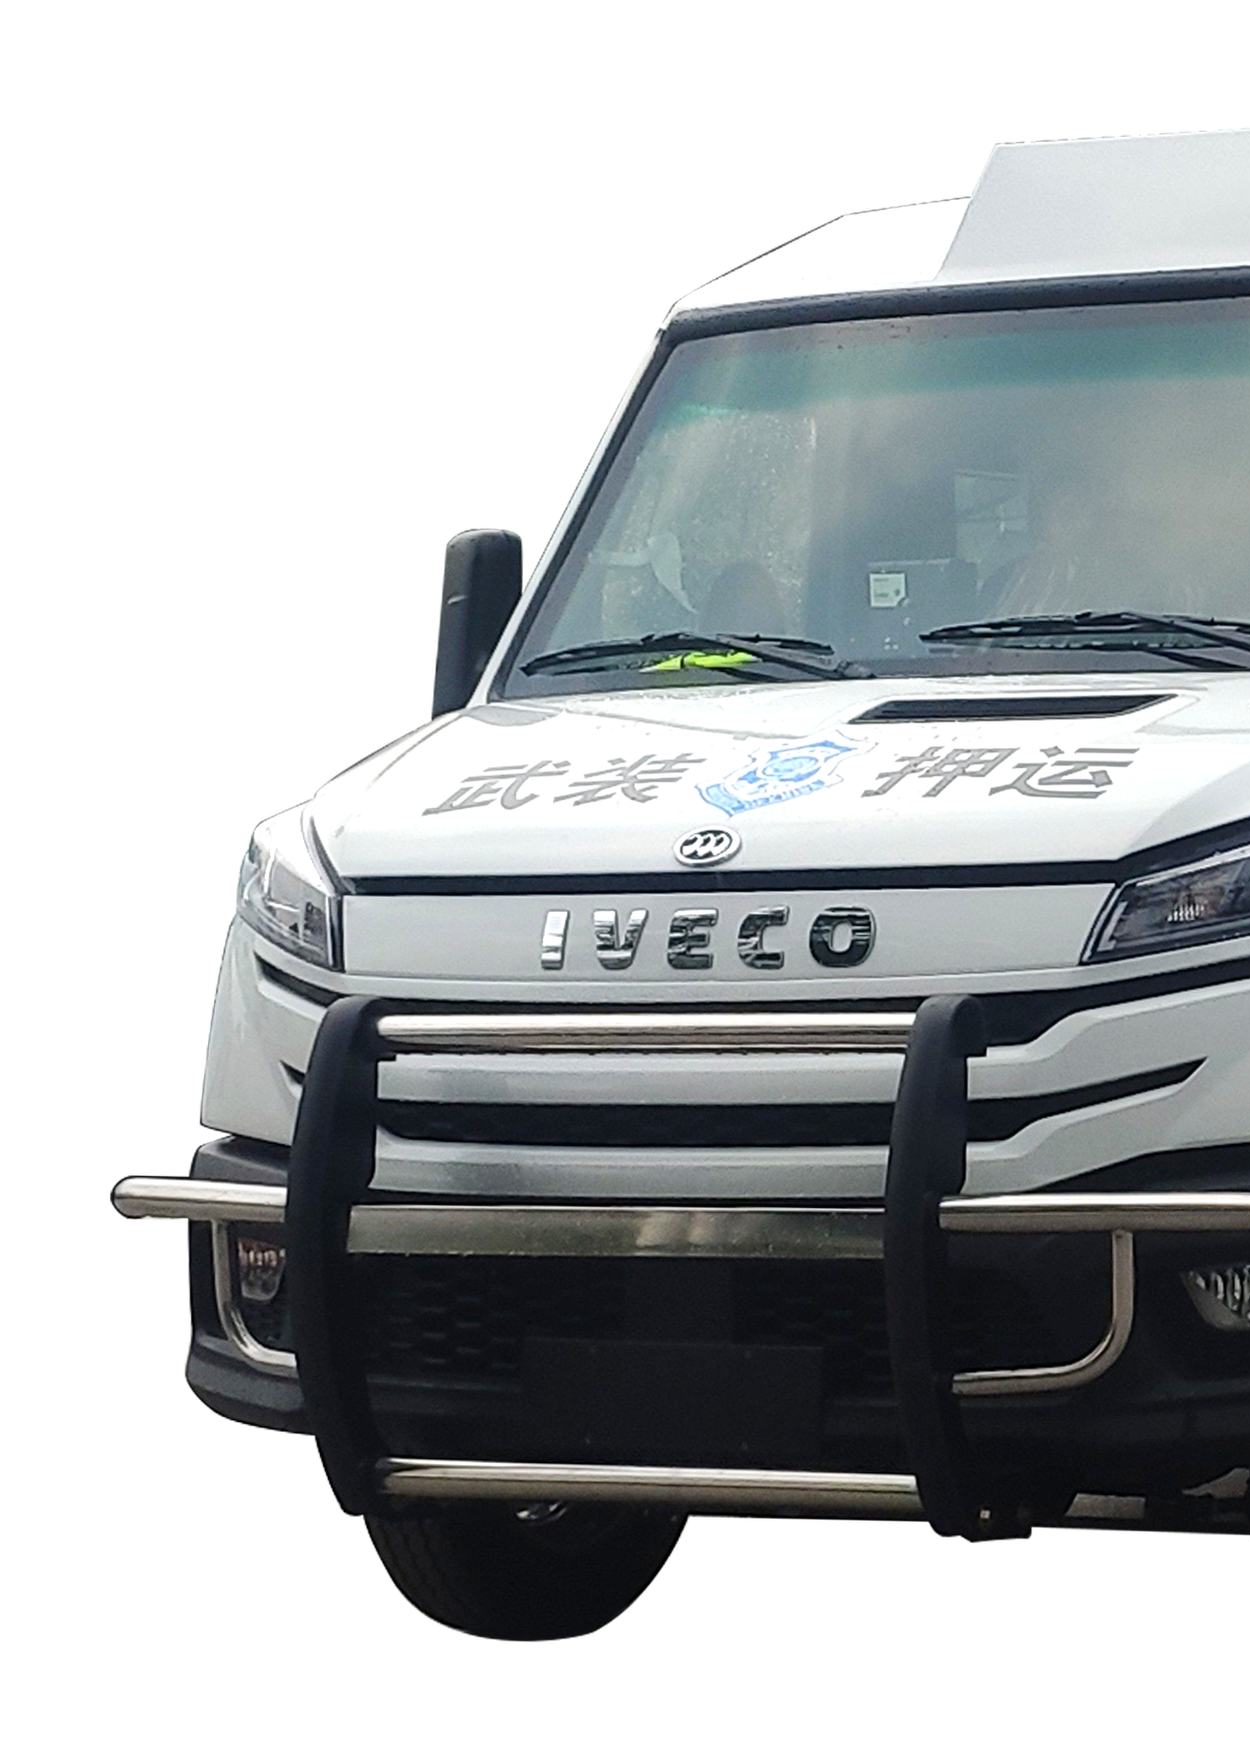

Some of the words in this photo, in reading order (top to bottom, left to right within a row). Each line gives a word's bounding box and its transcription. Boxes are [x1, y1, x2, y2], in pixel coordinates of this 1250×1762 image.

[422, 752, 706, 817] 武装
[861, 745, 1140, 798] 押运
[540, 905, 876, 970] IVECO
